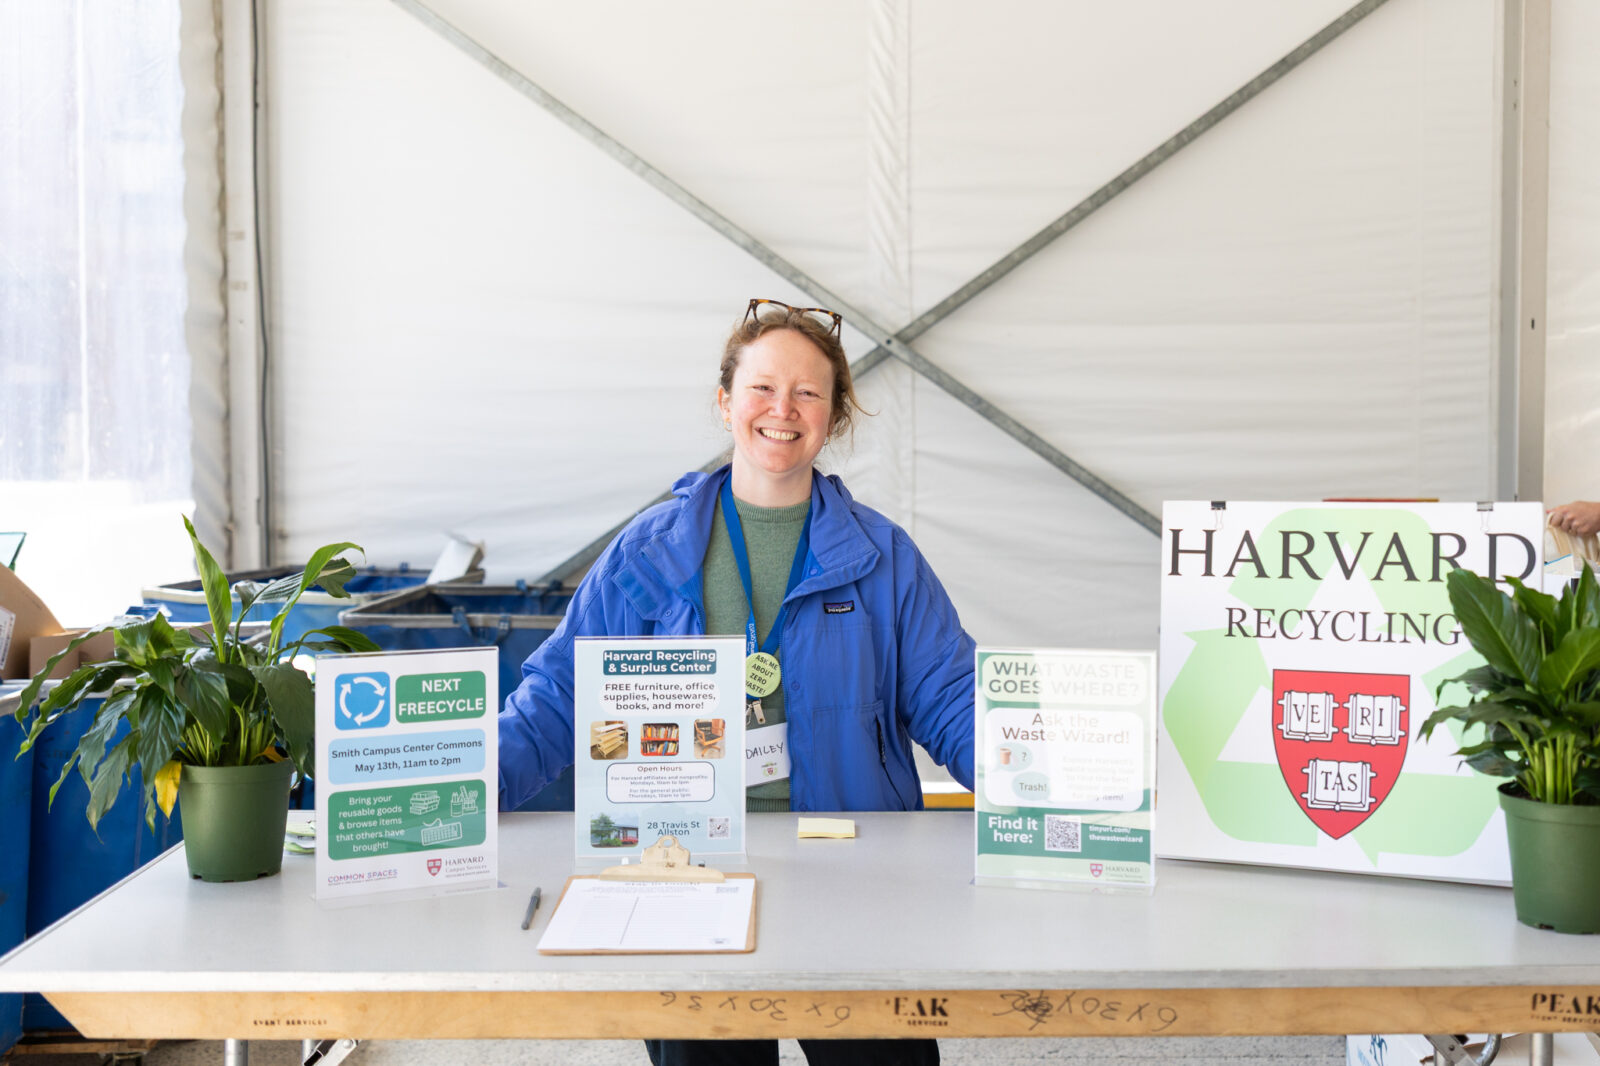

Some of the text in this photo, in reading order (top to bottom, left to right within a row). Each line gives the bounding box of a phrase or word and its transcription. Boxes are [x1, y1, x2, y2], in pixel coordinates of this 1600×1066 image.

[1167, 528, 1537, 583] HARVARD
[1224, 606, 1463, 646] RECYCLING
[603, 650, 716, 662] Harvard Recycling
[756, 654, 778, 670] ASK ME
[608, 662, 712, 674] & Surplus Center
[752, 664, 774, 678] ABOUT
[992, 661, 1135, 679] WHAT WASTE
[422, 678, 462, 693] NEXT
[750, 672, 766, 684] ZERO
[605, 682, 715, 692] FREE furniture, office
[988, 679, 1139, 697] GOES WHERE?
[604, 692, 716, 702] supplies, housewares,
[398, 698, 484, 716] FREECYCLE
[616, 702, 704, 711] books, and more!
[1032, 713, 1098, 728] Ask the
[1002, 727, 1130, 744] Waste Wizard!
[332, 740, 483, 758] Smith Campus Center Commons
[746, 742, 784, 760] DAILEY
[355, 756, 462, 774] May 13th, 11am to 2pm
[1018, 782, 1047, 792] Trash!
[1321, 770, 1358, 793] TAS
[349, 795, 392, 806] Bring your
[338, 804, 402, 818] reusable goods
[338, 817, 402, 830] & browse items
[988, 816, 1038, 831] Find it
[336, 828, 406, 842] that others have
[994, 830, 1033, 844] here:
[352, 841, 389, 852] brought!
[445, 856, 484, 866] HARVARD
[328, 872, 365, 883] COMMON
[367, 868, 398, 879] SPACES
[886, 997, 948, 1017] EAK
[1532, 992, 1600, 1014] PEAK
